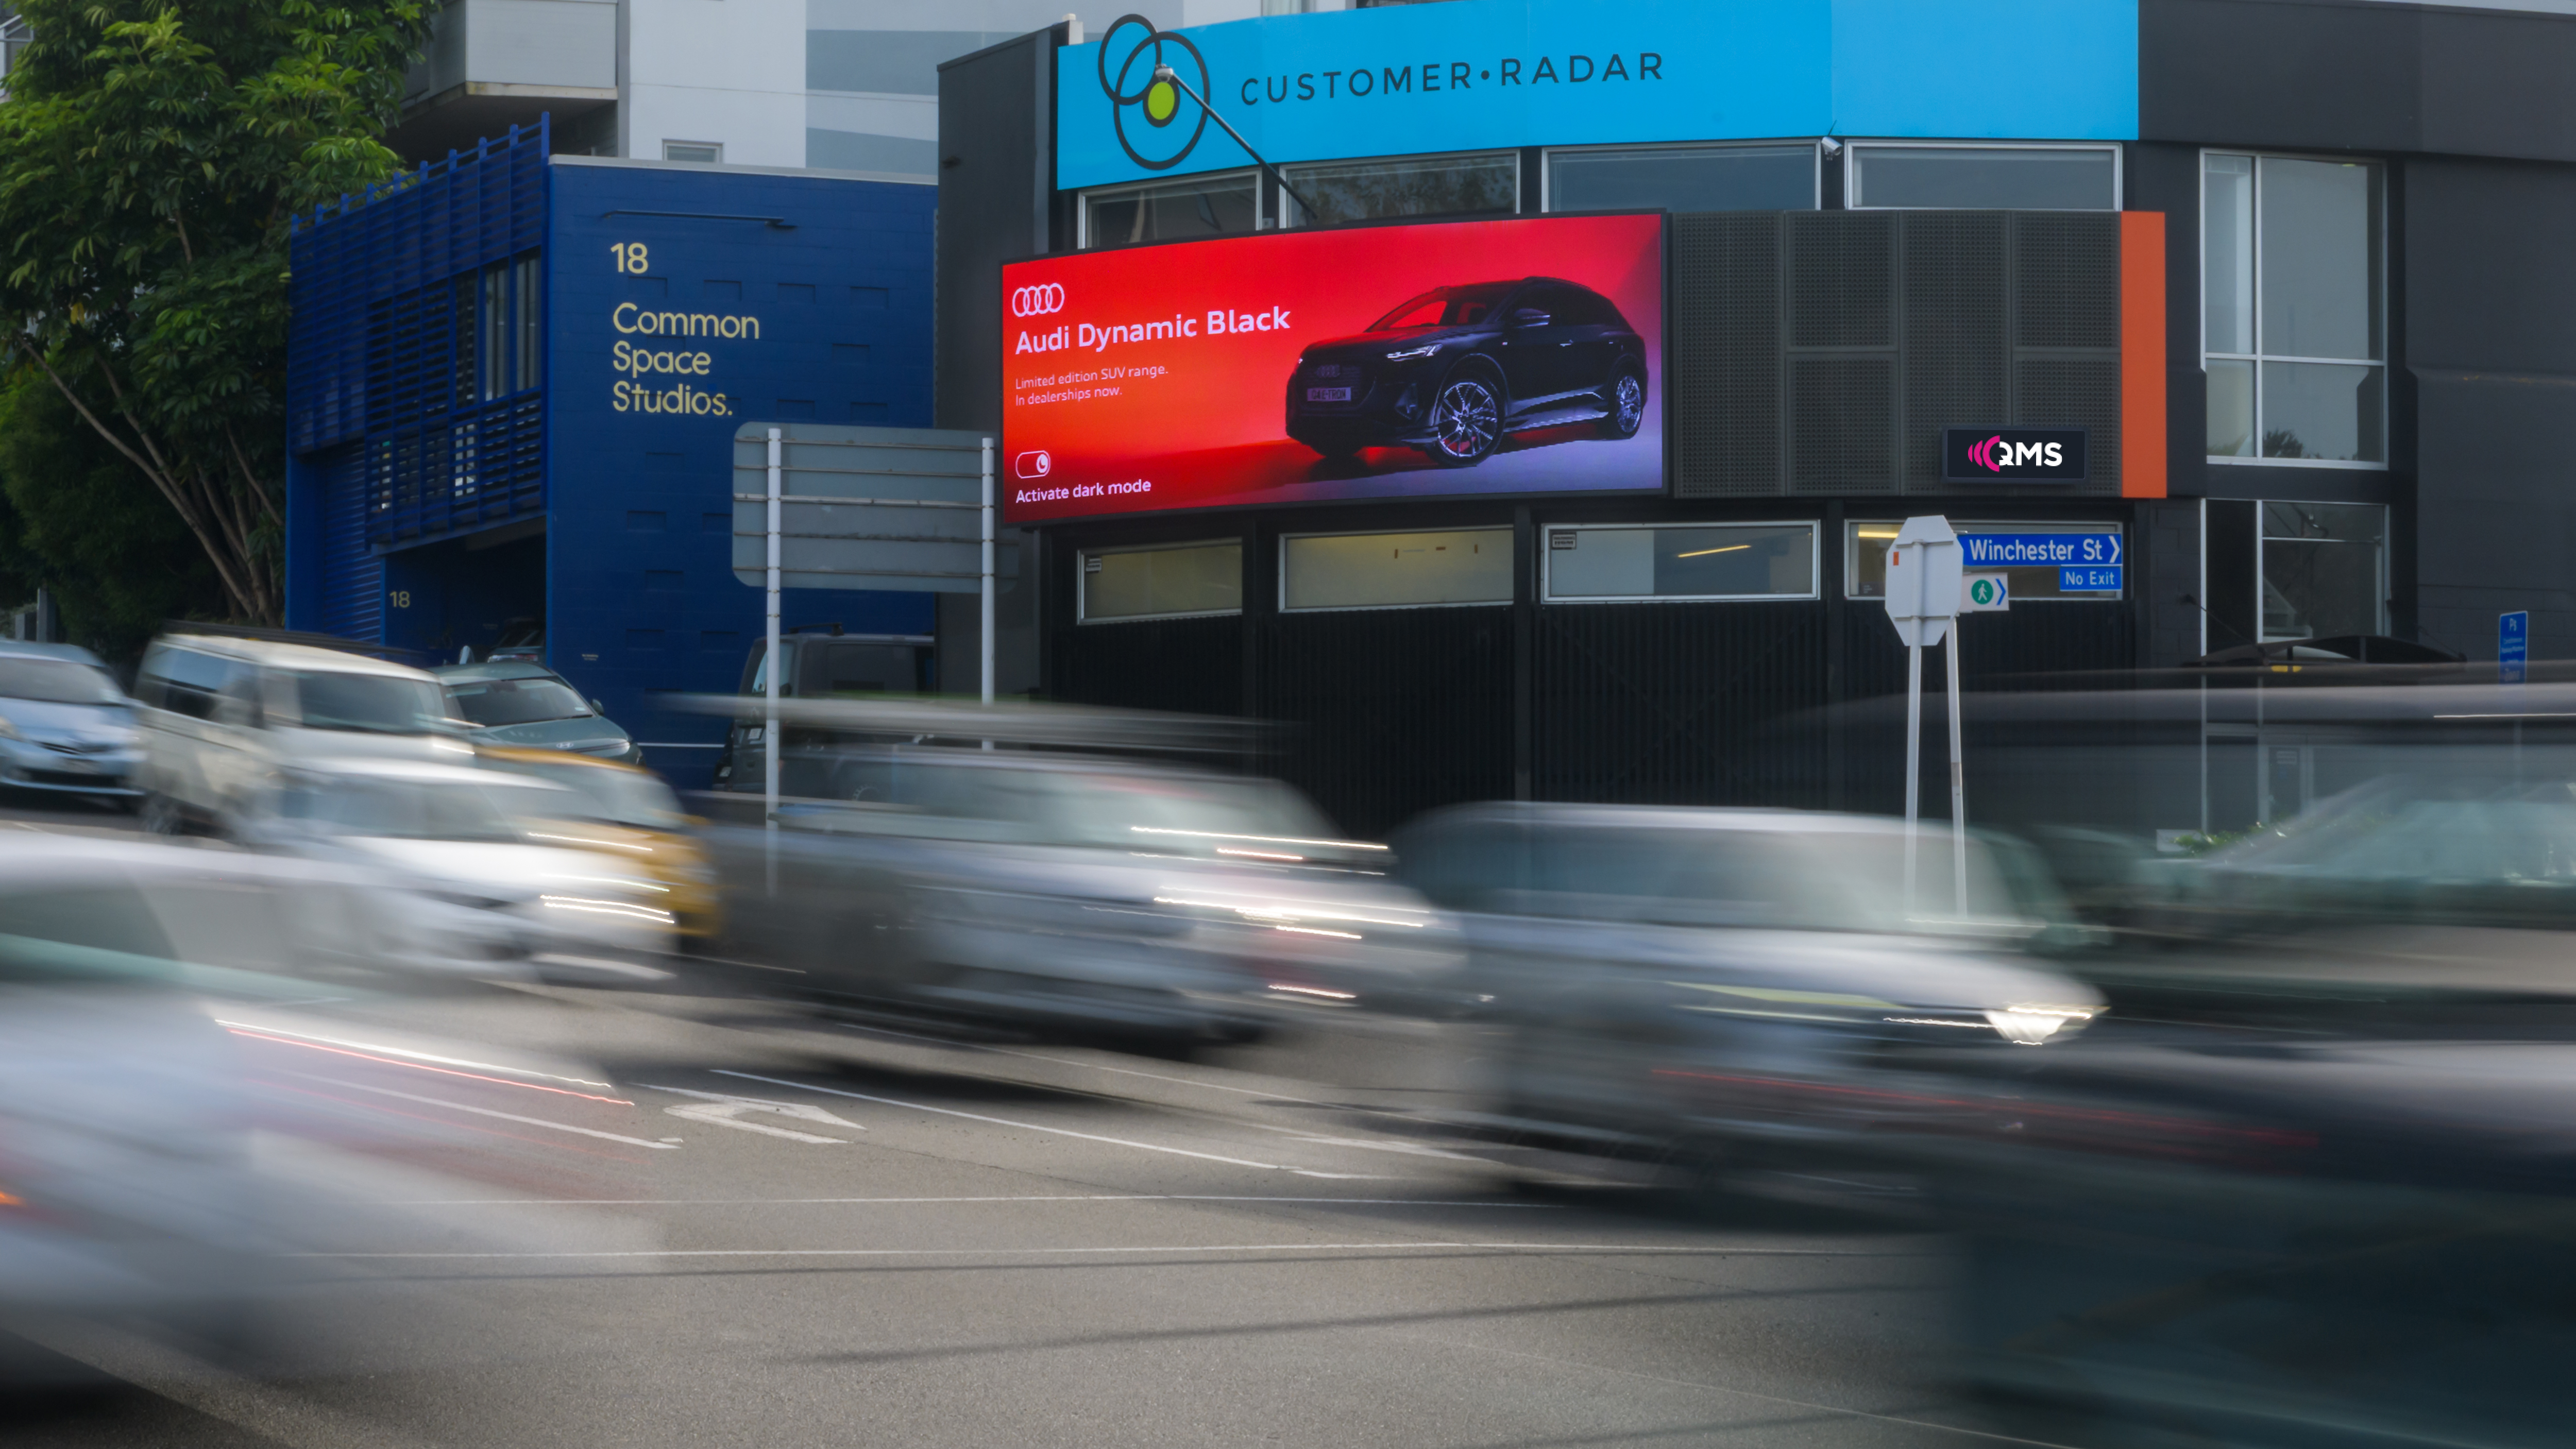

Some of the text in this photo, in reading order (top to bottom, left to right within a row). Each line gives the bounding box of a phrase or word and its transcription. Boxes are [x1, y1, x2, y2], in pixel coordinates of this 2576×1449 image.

[611, 242, 649, 275] 18
[613, 302, 759, 339] Common
[1015, 306, 1291, 354] Audi Dynamic Black
[613, 340, 711, 379] Space
[1016, 365, 1168, 390] Limited edition SUV range.
[613, 380, 733, 416] Studios.
[1015, 386, 1122, 406] In dealerships now.
[1984, 435, 2062, 472] QMS
[1015, 479, 1151, 504] Activate dark mode
[1970, 539, 2102, 560] Winchester St
[2065, 571, 2115, 585] No Exit
[389, 591, 410, 608] 18
